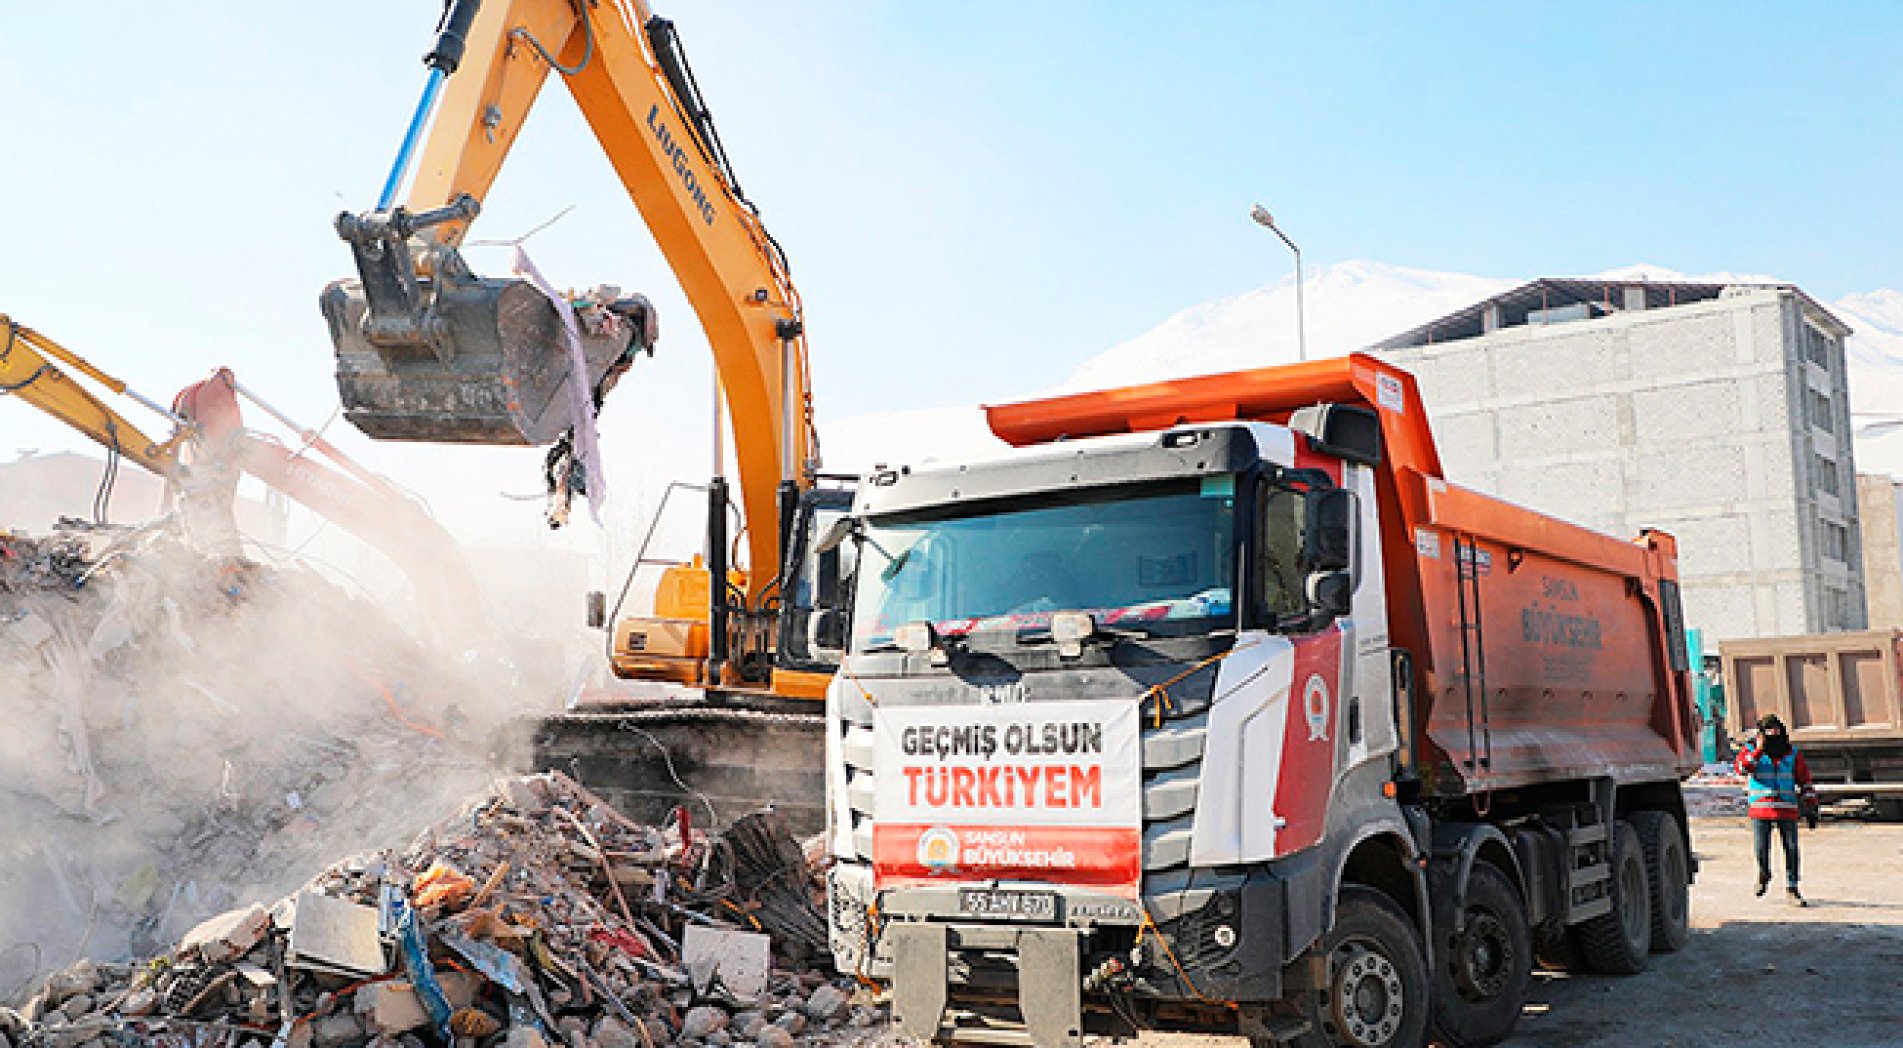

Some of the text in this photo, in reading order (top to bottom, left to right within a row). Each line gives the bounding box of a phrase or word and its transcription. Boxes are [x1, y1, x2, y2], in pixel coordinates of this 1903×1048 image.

[902, 722, 1102, 761] GEÇMİŞ OLSUN
[902, 764, 1102, 808] TÜRKİYEM
